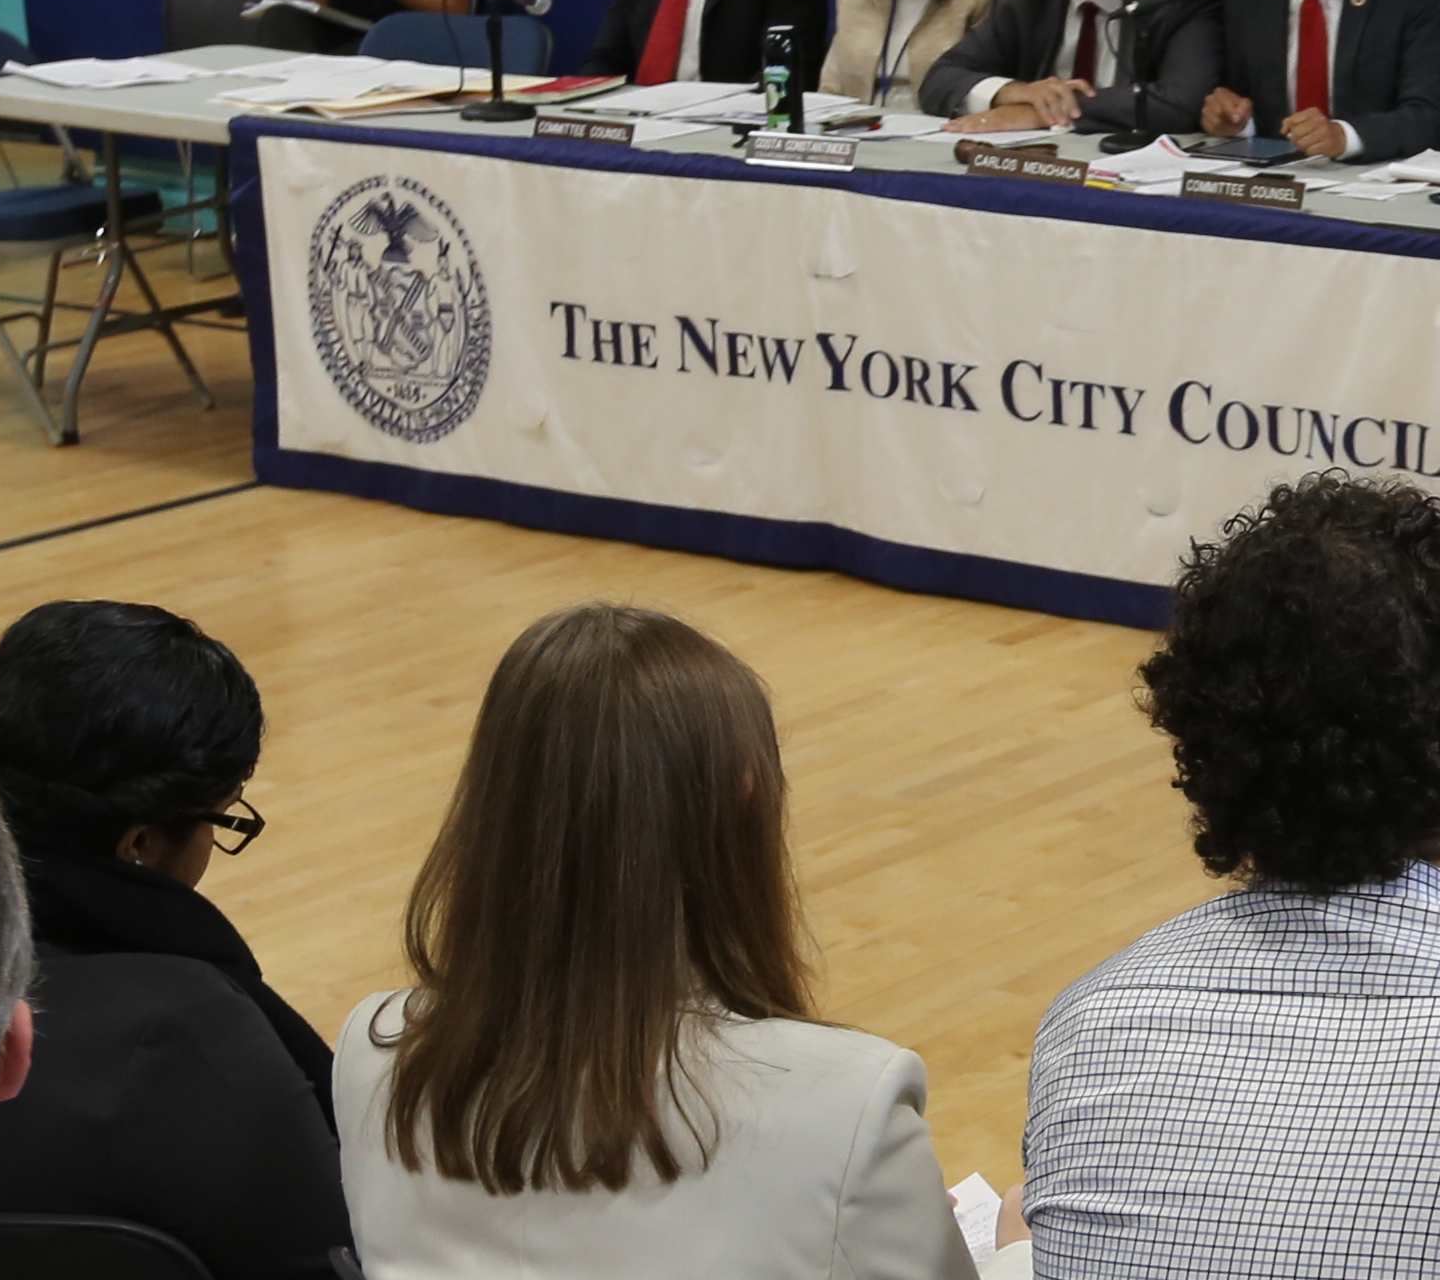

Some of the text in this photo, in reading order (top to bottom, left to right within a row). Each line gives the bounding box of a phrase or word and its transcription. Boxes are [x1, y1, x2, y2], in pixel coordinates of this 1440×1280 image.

[537, 120, 629, 141] COMMITTEE COUNSEL
[974, 154, 1082, 179] CARLOS MENCHACA
[1185, 179, 1298, 202] COMMITTEE COUNSEL
[550, 301, 659, 368] THE
[675, 314, 806, 386] NEW
[815, 331, 980, 412] YORK
[1000, 358, 1145, 437] CITY
